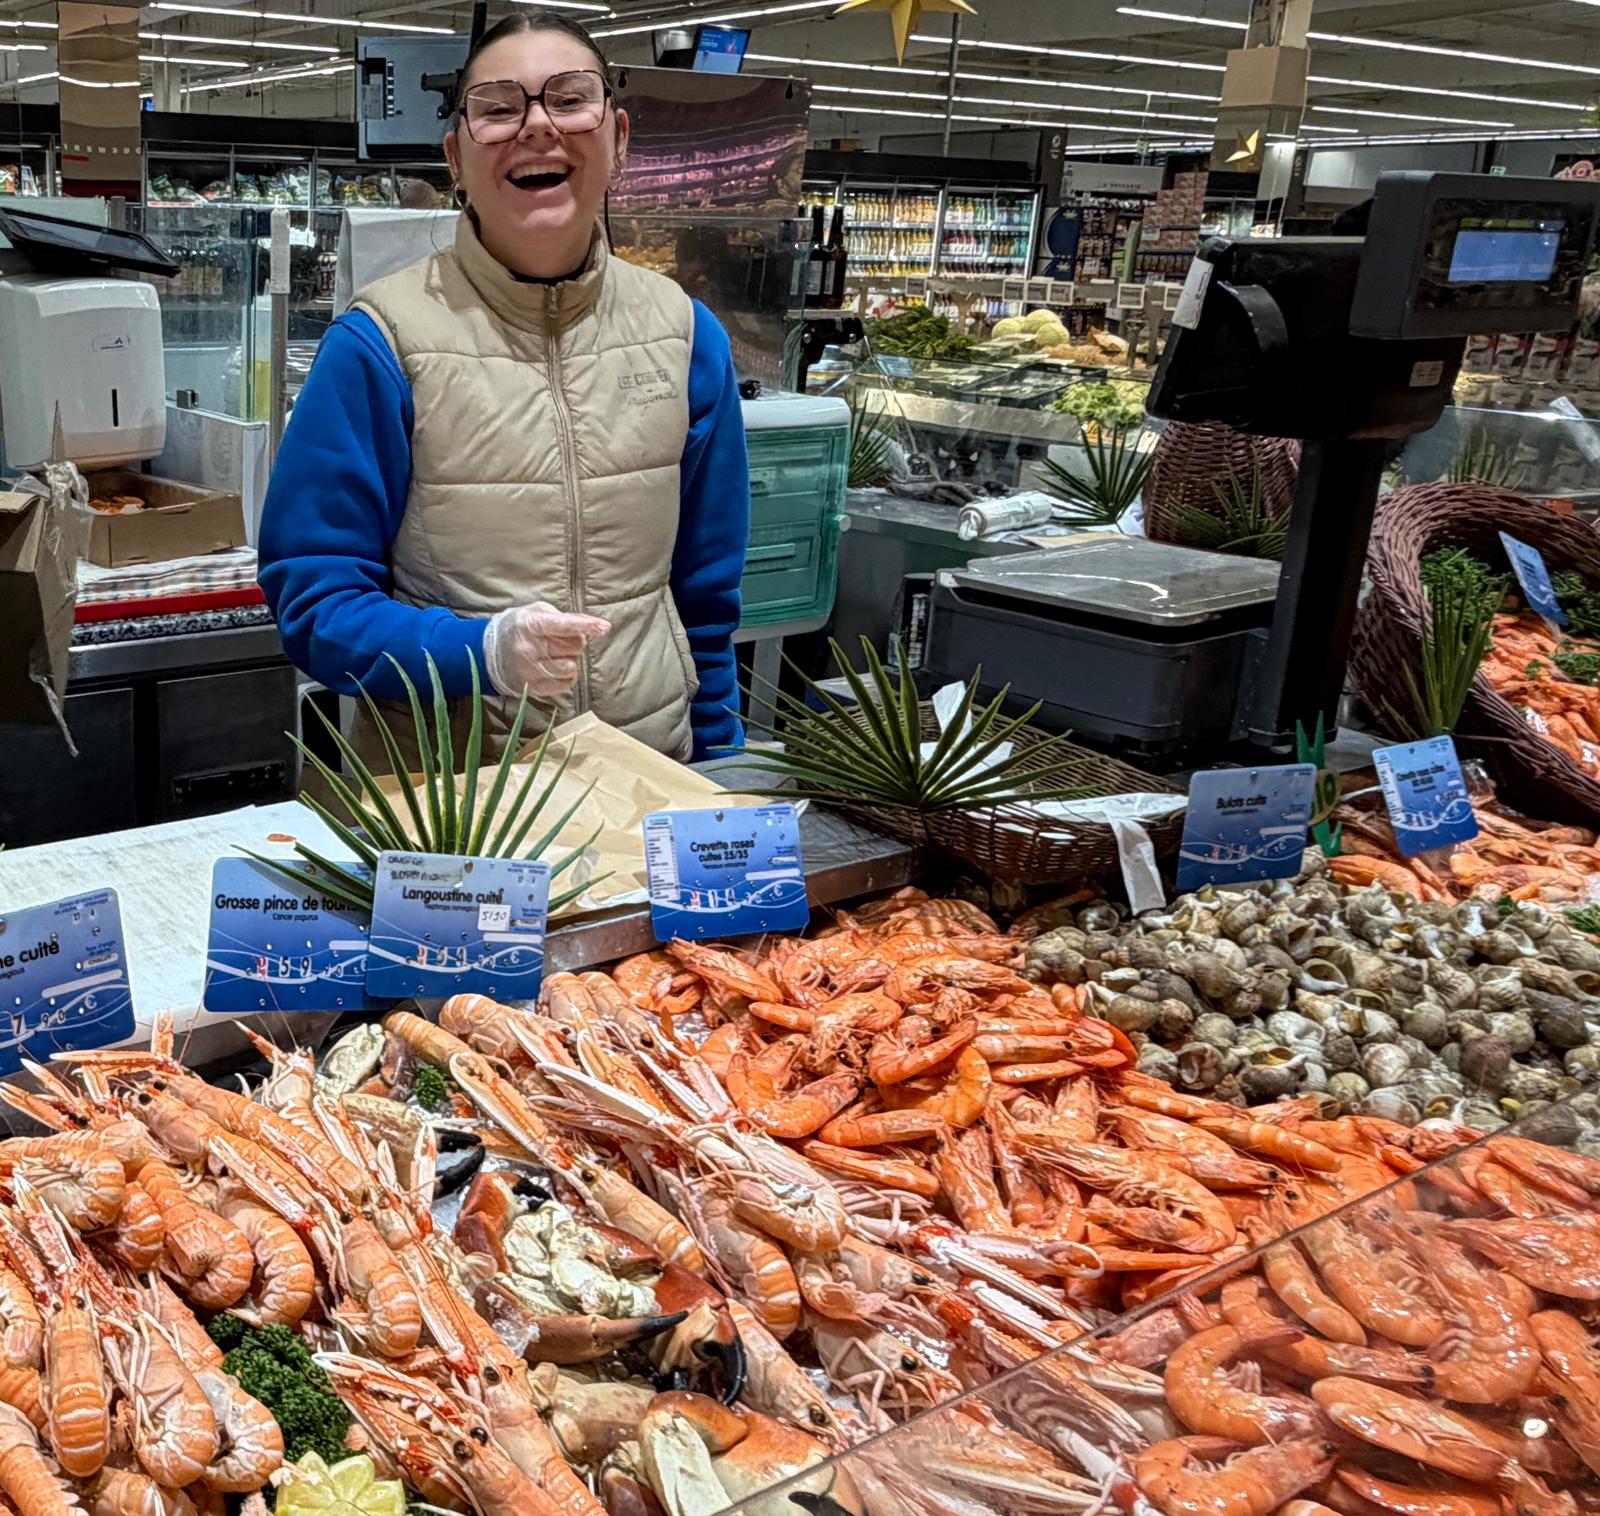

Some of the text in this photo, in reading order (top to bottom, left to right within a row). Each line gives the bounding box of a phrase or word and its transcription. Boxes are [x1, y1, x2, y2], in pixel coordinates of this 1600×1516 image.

[690, 840, 728, 852] Crevette
[215, 893, 260, 910] Grosse
[263, 894, 298, 913] pince
[302, 895, 319, 910] de
[402, 886, 473, 904] Langoustine
[272, 912, 293, 921] Cancer
[19, 941, 60, 963] cuite
